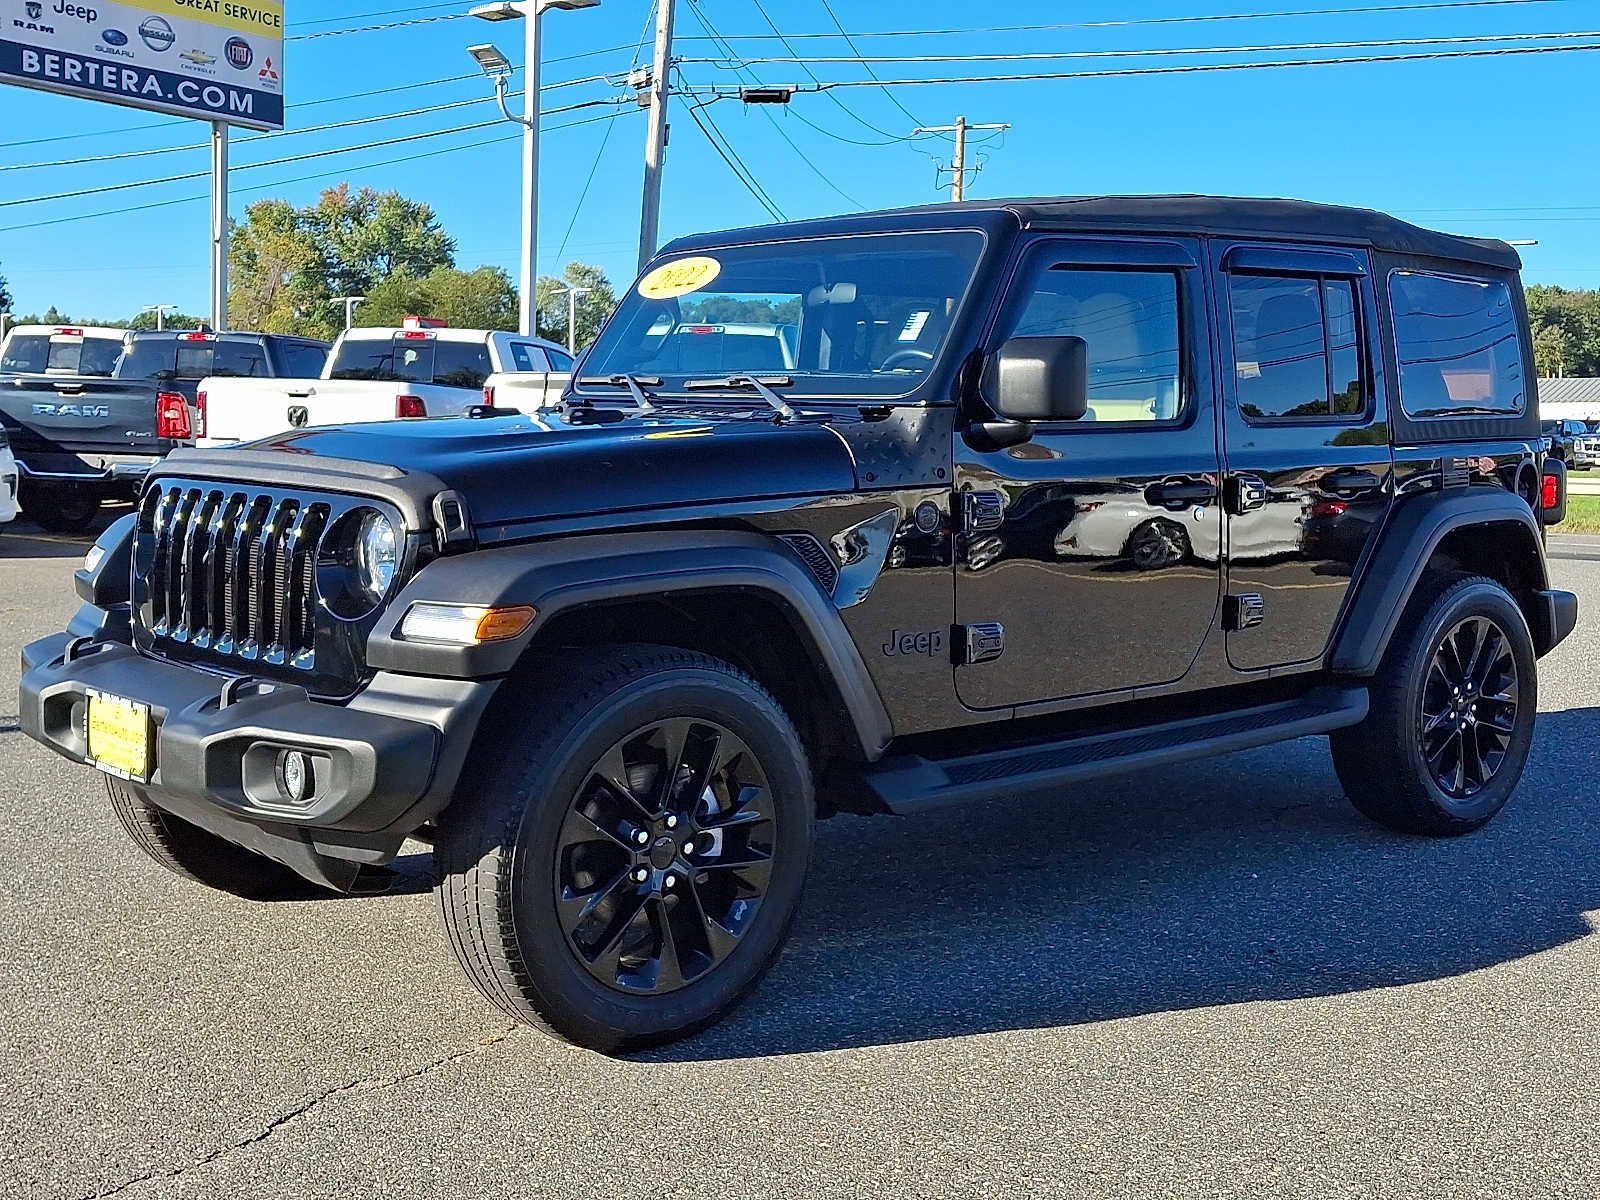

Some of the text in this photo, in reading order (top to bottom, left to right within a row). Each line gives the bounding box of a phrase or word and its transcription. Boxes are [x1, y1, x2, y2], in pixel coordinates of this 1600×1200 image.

[53, 0, 97, 23] Jeep
[224, 3, 280, 27] SERVICE
[13, 19, 55, 34] RAM
[95, 44, 135, 58] SUBARU
[231, 45, 249, 63] FIAT
[22, 49, 254, 114] BERTERA.COM
[31, 404, 109, 417] RAM
[882, 629, 942, 657] Jeep
